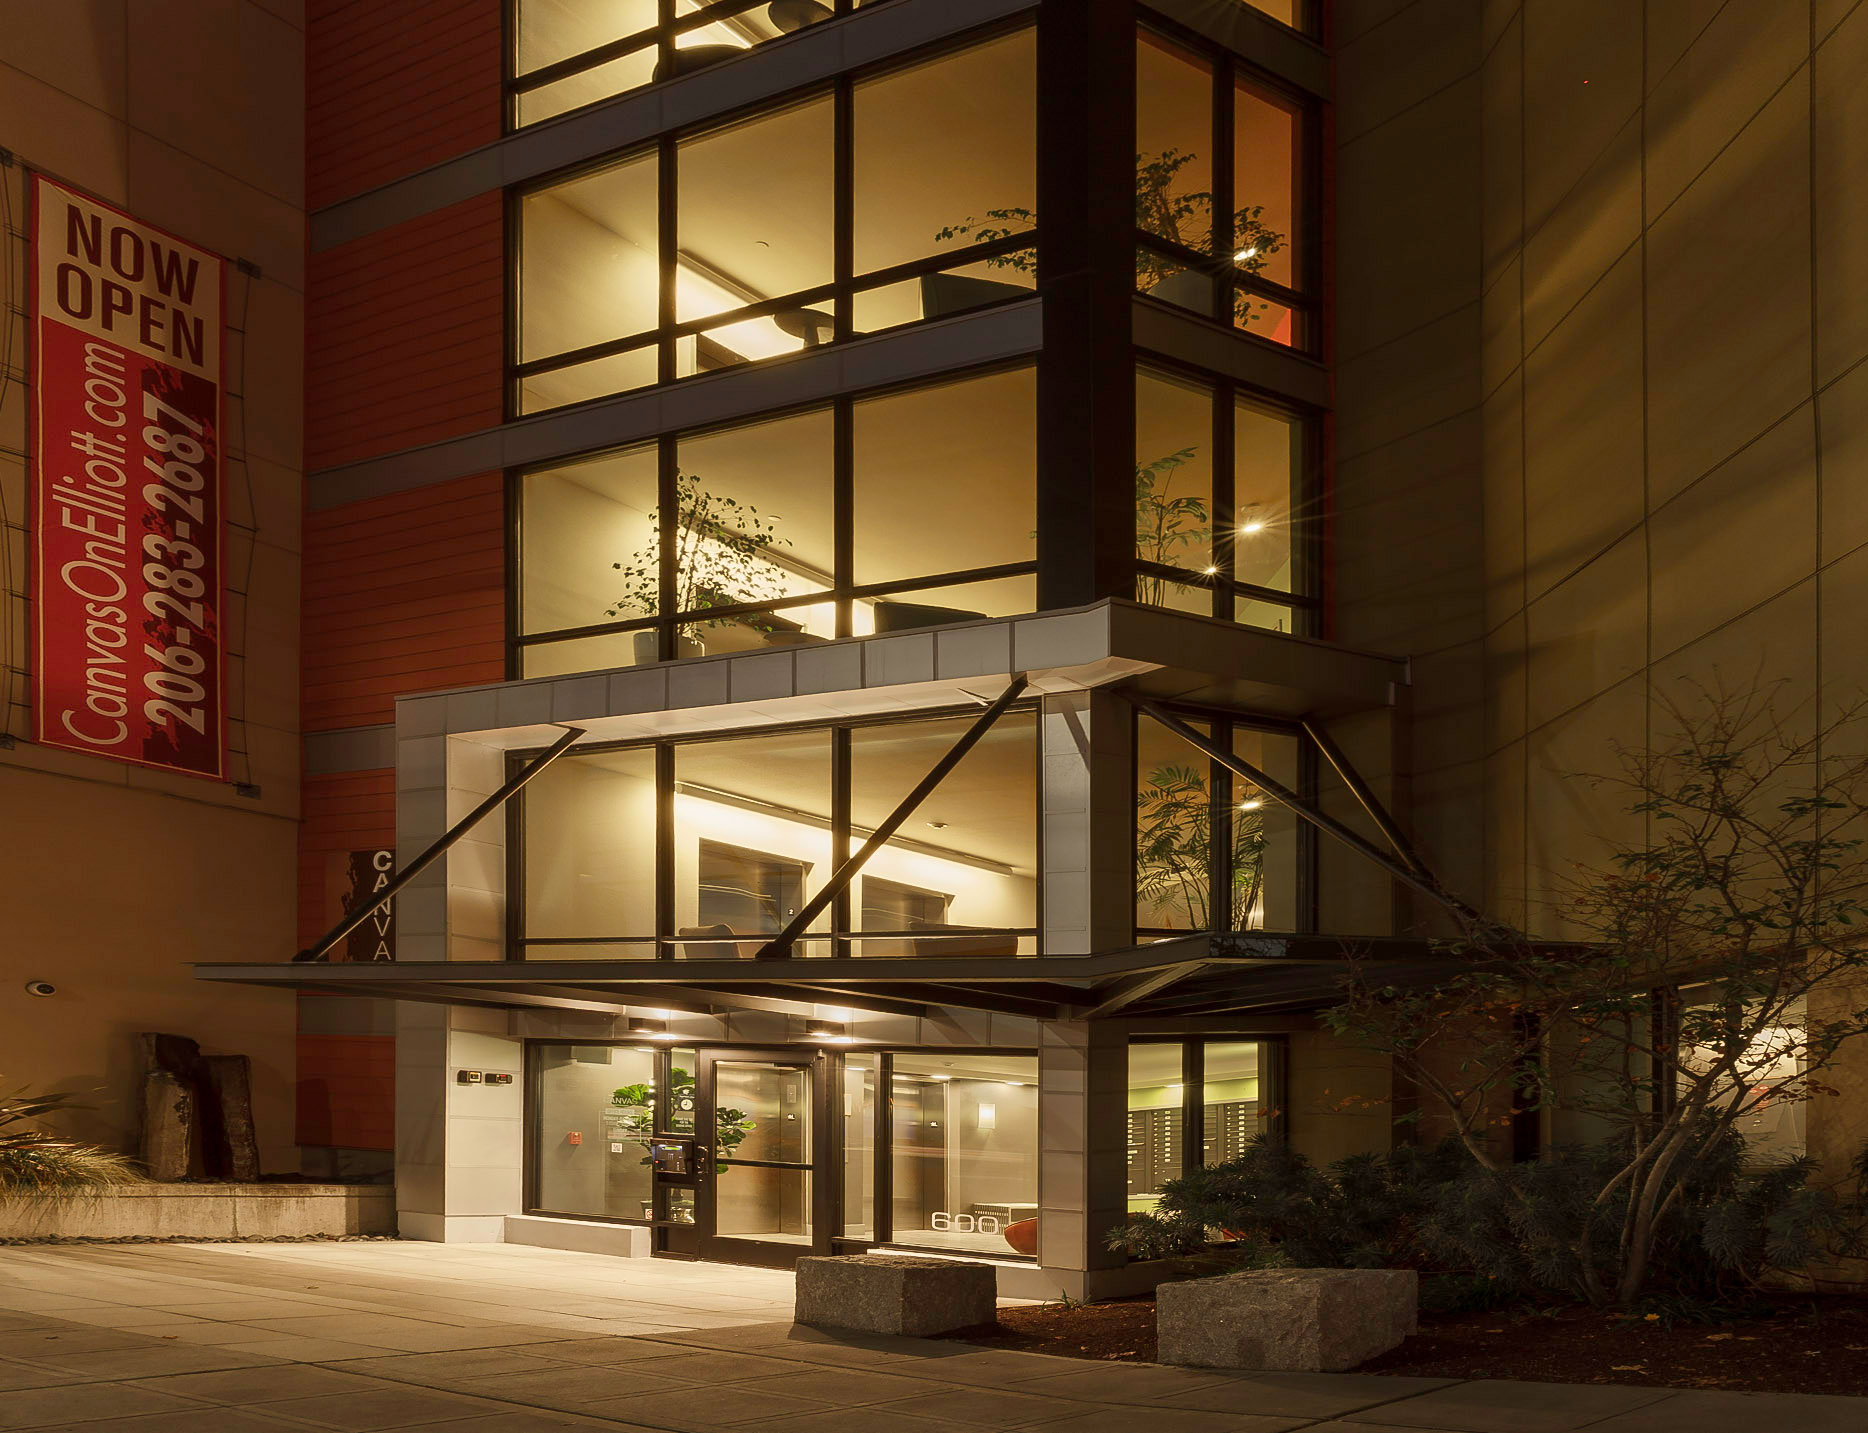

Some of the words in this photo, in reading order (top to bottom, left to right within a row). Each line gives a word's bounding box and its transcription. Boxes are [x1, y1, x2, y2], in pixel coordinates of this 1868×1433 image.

[67, 203, 200, 306] NOW
[57, 262, 204, 368] OPEN
[52, 342, 128, 745] CanvasOnElliott.com
[142, 391, 206, 735] 206-283-2687
[373, 851, 392, 960] CANVA
[931, 1211, 999, 1235] 600
